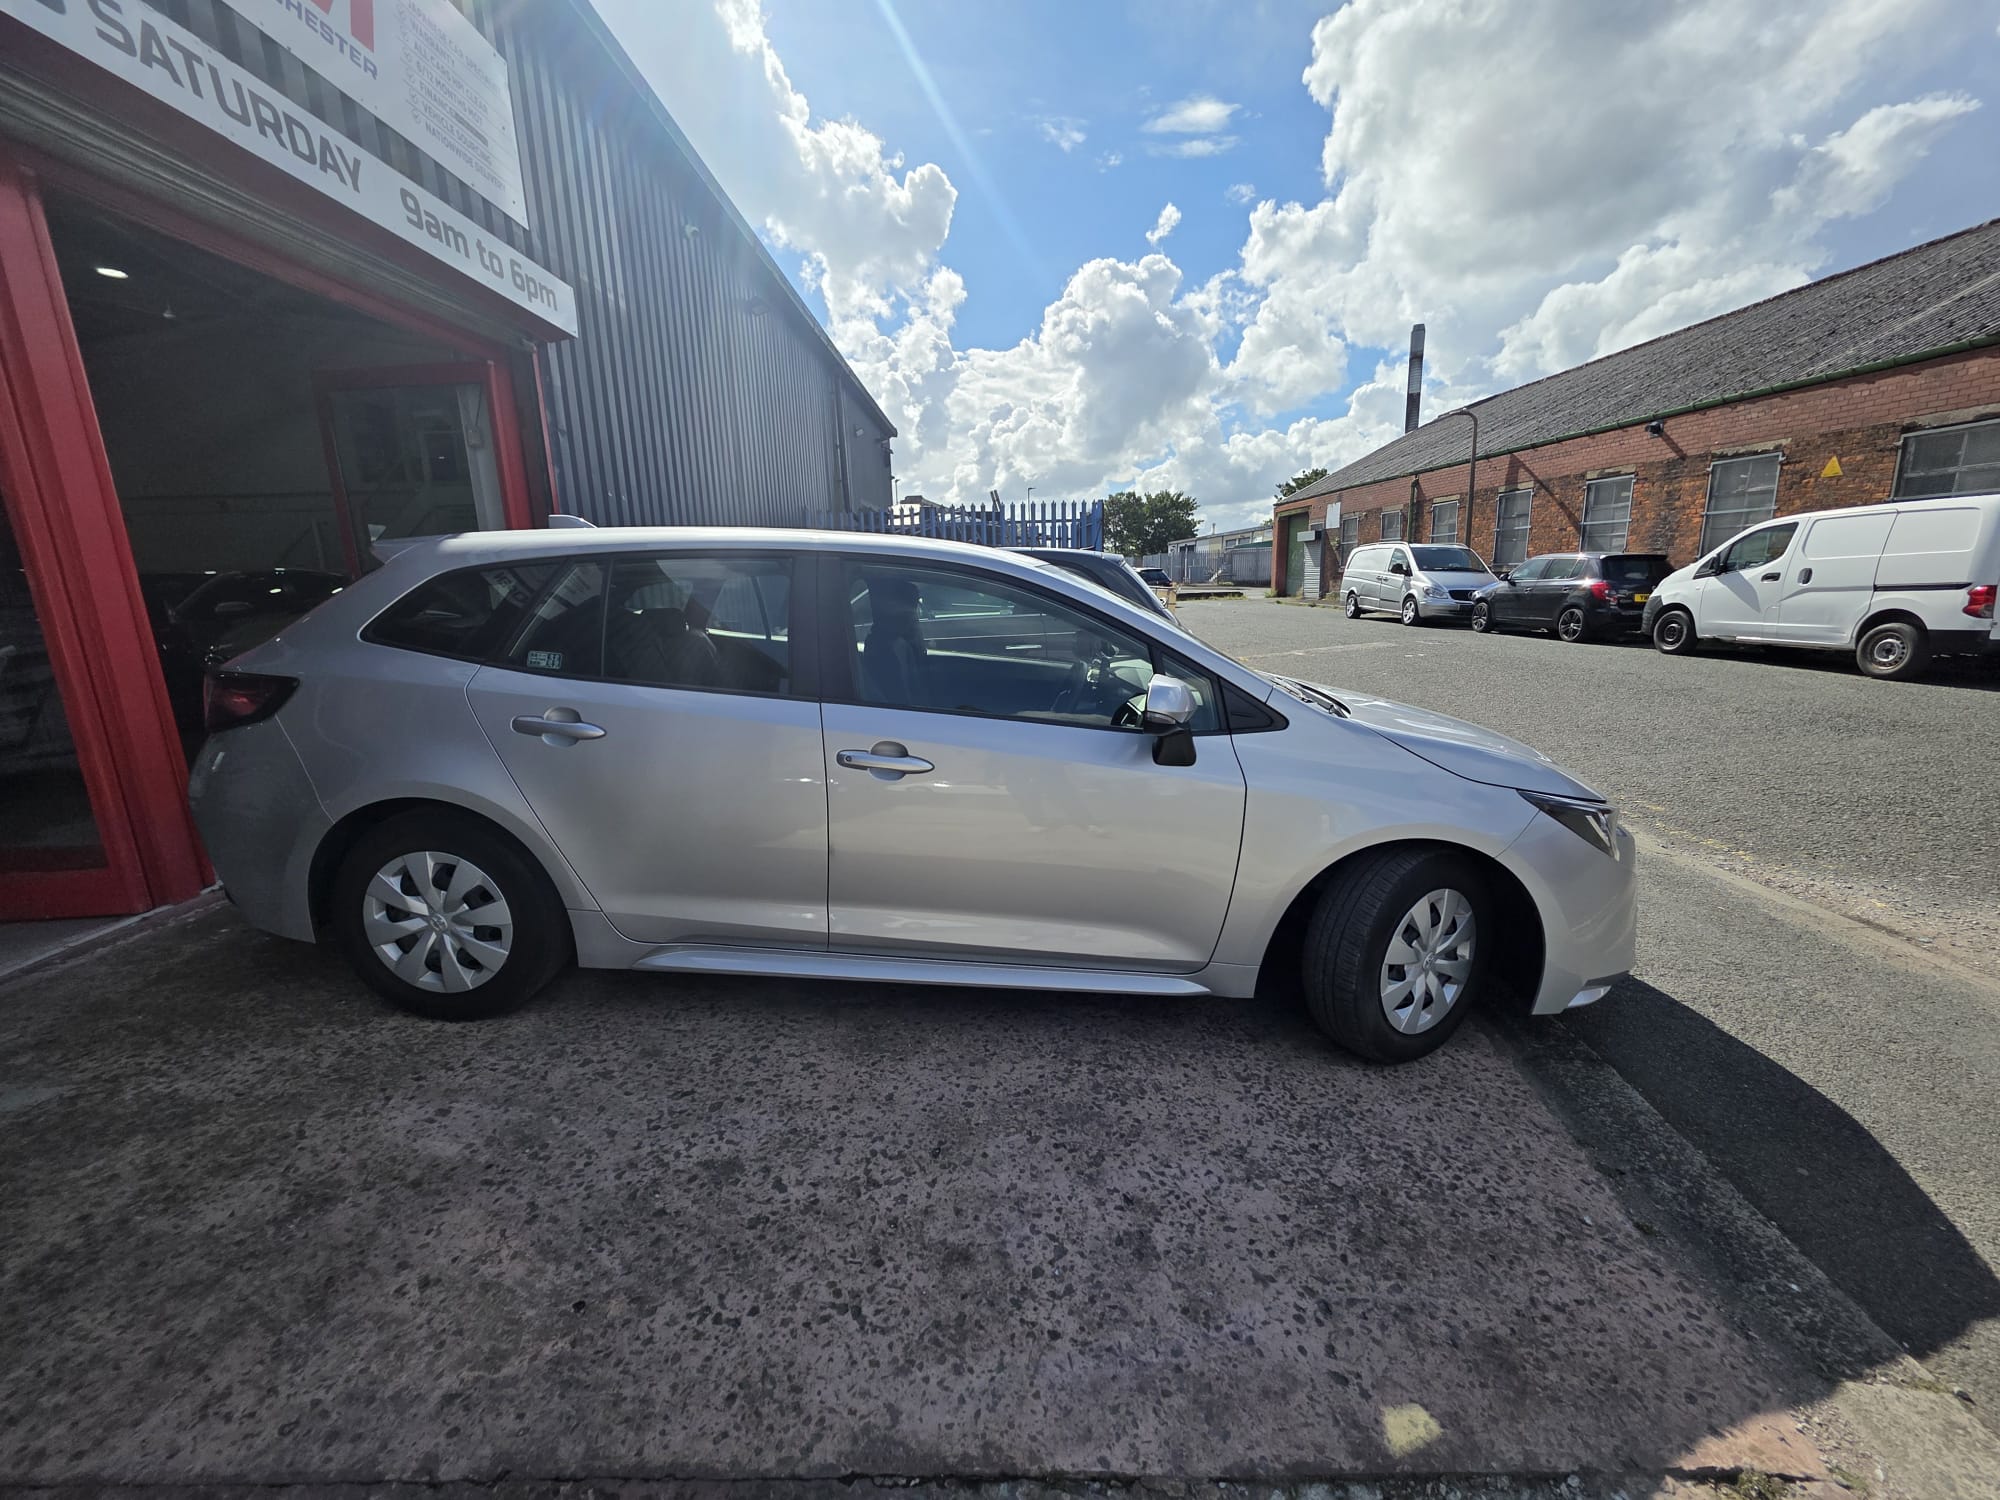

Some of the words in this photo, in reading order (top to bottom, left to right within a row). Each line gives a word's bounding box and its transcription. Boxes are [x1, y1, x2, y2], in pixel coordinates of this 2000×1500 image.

[276, 0, 378, 80] HESTER
[409, 17, 454, 66] WARRANTY
[414, 40, 429, 61] ALL
[416, 61, 434, 83] 6/12
[434, 76, 466, 111] MONTHS
[87, 0, 361, 194] SATURDAY
[400, 187, 471, 259] 9am
[476, 238, 504, 280] to
[509, 258, 558, 311] 6pm
